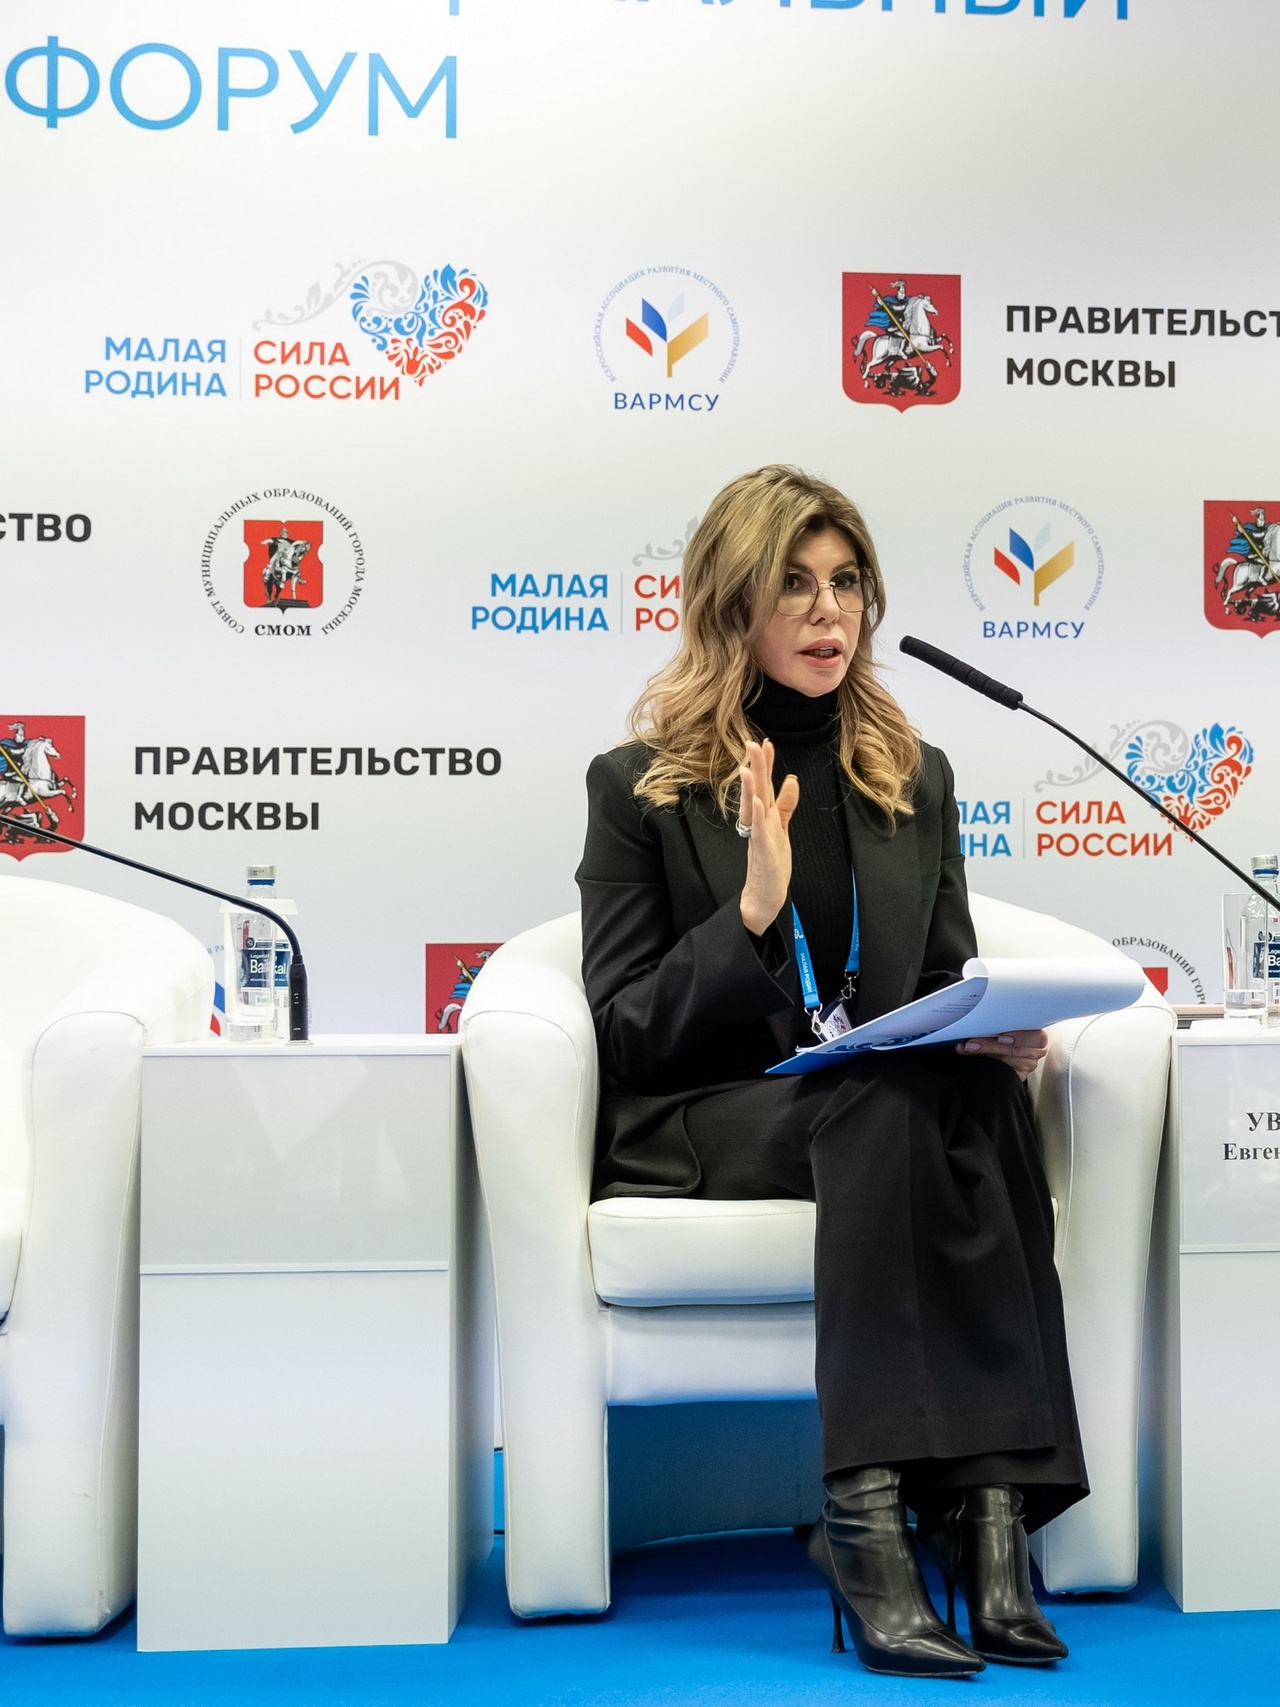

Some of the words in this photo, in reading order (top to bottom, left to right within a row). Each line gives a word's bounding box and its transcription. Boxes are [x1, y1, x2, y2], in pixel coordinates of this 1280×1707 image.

[4, 35, 457, 139] ФОРУМ
[647, 265, 692, 276] РАЗВИТИЯ
[104, 336, 227, 364] МАЛАЯ
[252, 340, 350, 367] СИЛА
[84, 369, 227, 399] РОДИНА
[254, 373, 401, 400] РОССИИ
[1006, 357, 1176, 388] МОСКВЫ
[614, 392, 720, 411] ВАРМСУ
[263, 488, 353, 532] ОБРАЗОВАНИЙ
[1014, 495, 1058, 506] РАЗВИТИЯ
[0, 512, 92, 543] ТВО
[201, 492, 261, 598] МУНИЦИПАЛЬНЫХ
[348, 532, 366, 583] ГОРОДА
[490, 573, 608, 598] МАЛАЯ
[210, 600, 245, 634] СОВЕТ
[321, 585, 363, 635] МОСКВЫ
[471, 605, 609, 634] РОДИНА
[254, 624, 312, 636] СМОМ
[983, 621, 1085, 639] ВАРМСУ
[134, 746, 502, 777] ПРАВИТЕЛЬСТВО
[134, 801, 320, 831] МОСКВЫ
[1035, 800, 1127, 825] СИЛА
[1037, 832, 1173, 857] РОССИИ
[1111, 936, 1196, 977] ОБРАЗОВАНИЙ
[1191, 977, 1207, 1004] ГОР
